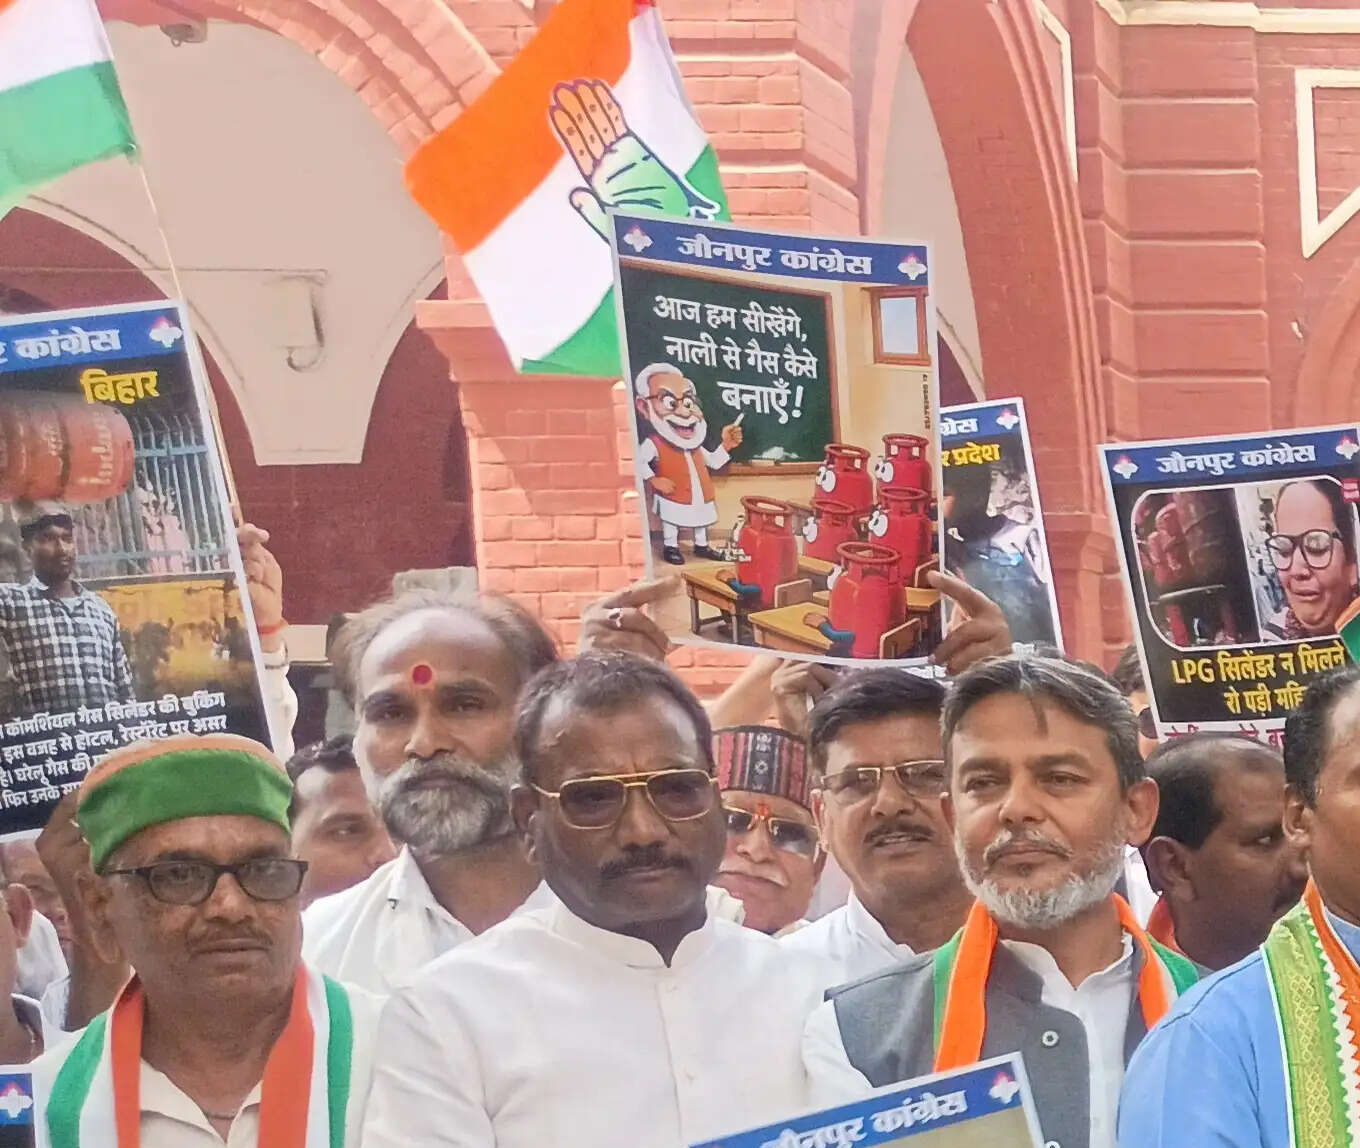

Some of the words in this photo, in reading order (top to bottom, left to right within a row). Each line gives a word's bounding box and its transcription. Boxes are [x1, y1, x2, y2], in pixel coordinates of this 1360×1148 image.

[676, 233, 772, 270] जौनपुर
[780, 246, 872, 275] कांग्रेस
[653, 295, 701, 323] आज
[704, 303, 737, 330] हम
[14, 326, 121, 359] कांग्रेस
[663, 332, 717, 367] नाली
[721, 336, 741, 371] से
[745, 338, 780, 375] गैस
[783, 343, 818, 379] कैसे
[80, 368, 160, 404] बिहार
[951, 441, 1000, 466] प्रदेश
[1156, 450, 1236, 476] जौनपुर
[1240, 442, 1316, 467] कांग्रेस
[1171, 657, 1214, 685] LPG
[1217, 648, 1277, 682] सिलेंडर
[1278, 653, 1296, 675] न
[1296, 641, 1347, 675] मिलने
[77, 704, 103, 724] गैस
[105, 700, 157, 722] सिलेंडर
[157, 694, 179, 714] की
[181, 690, 225, 716] बुकिंग
[1224, 685, 1241, 714] रो
[1244, 681, 1273, 717] पड़ी
[2, 744, 24, 764] इस
[25, 739, 58, 755] वजह
[59, 732, 73, 751] से
[169, 720, 191, 736] पर
[192, 715, 227, 732] असर
[14, 763, 50, 786] घरेलू
[45, 757, 70, 776] गैस
[70, 752, 91, 771] की
[2, 790, 28, 808] फिर
[28, 785, 60, 803] उनके
[870, 1090, 968, 1133] कांग्रेस
